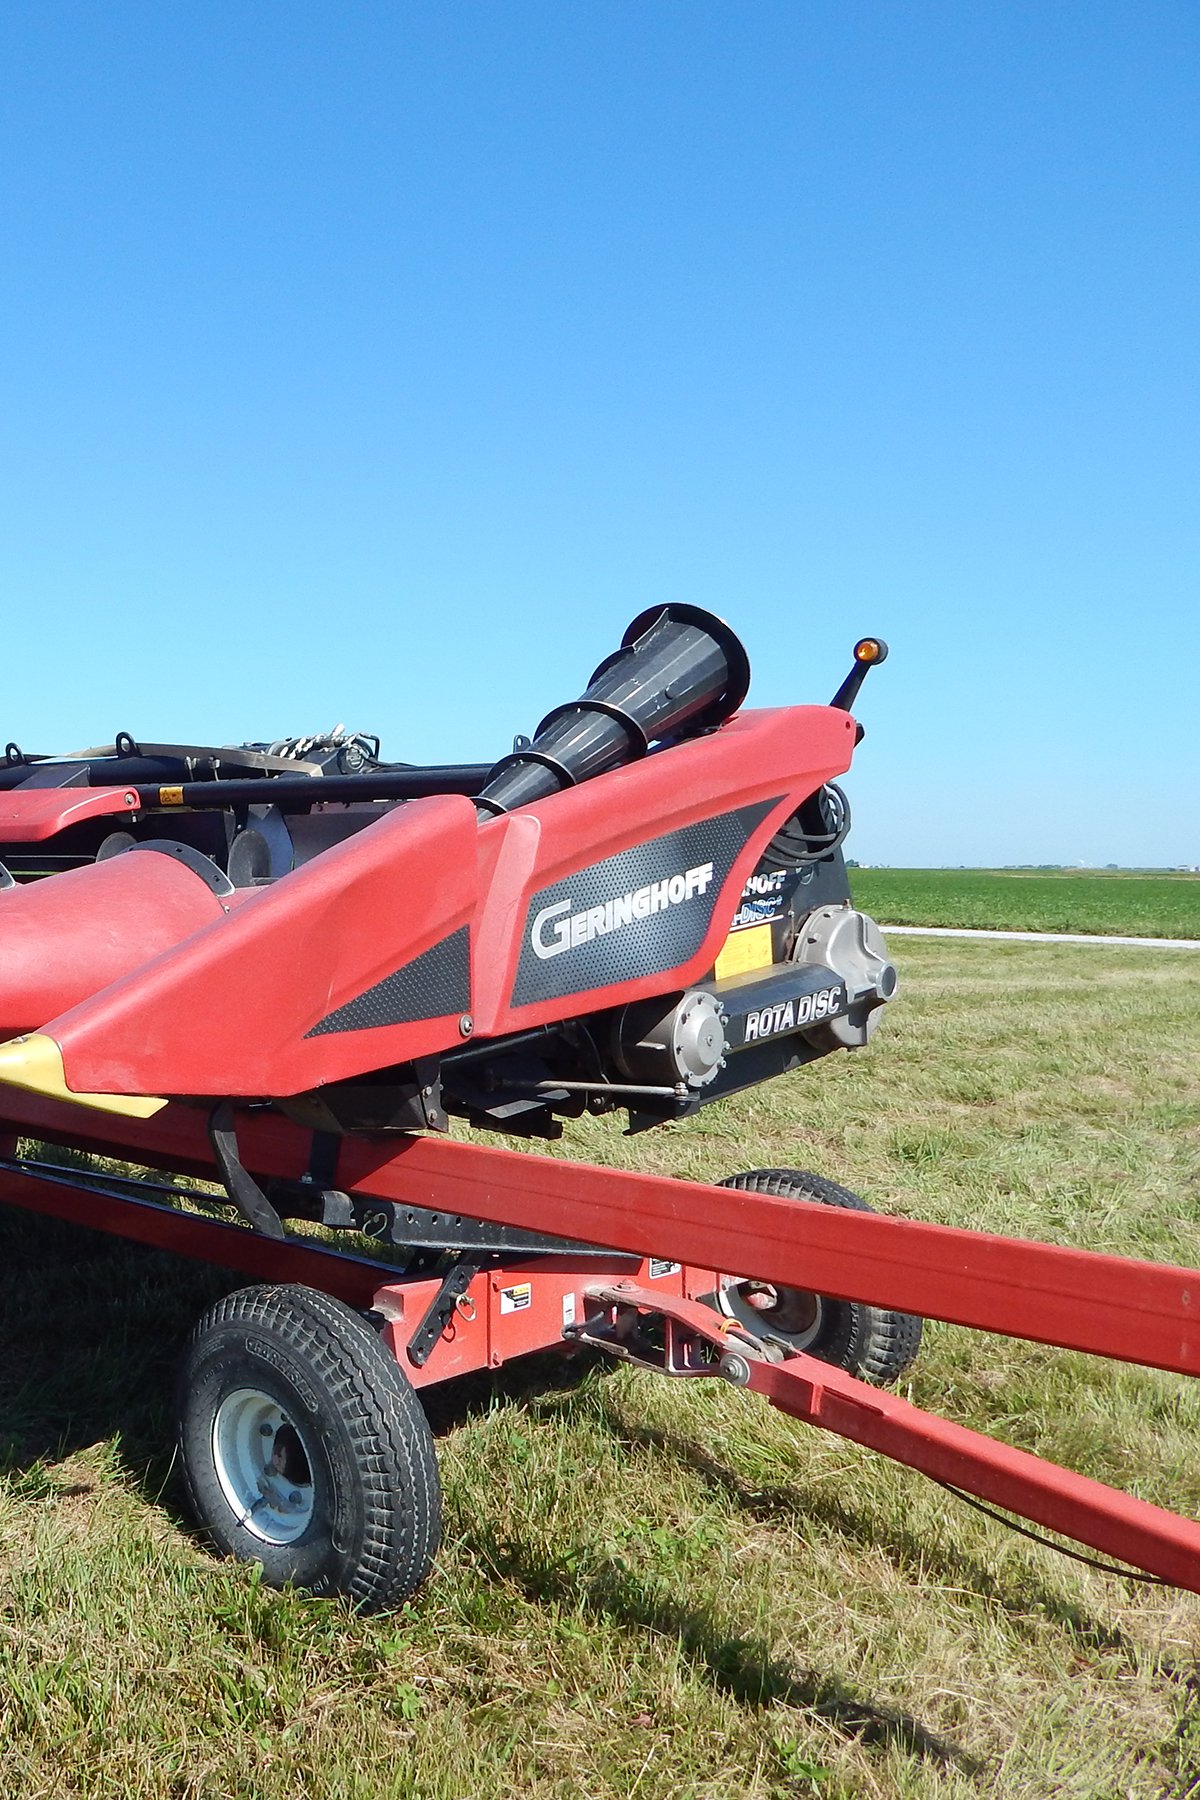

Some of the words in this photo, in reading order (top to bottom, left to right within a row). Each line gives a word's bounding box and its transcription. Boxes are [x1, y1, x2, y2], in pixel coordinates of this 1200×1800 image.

[531, 861, 713, 960] GERINGHOFF
[744, 1001, 794, 1042] ROTA
[797, 986, 841, 1025] DISC
